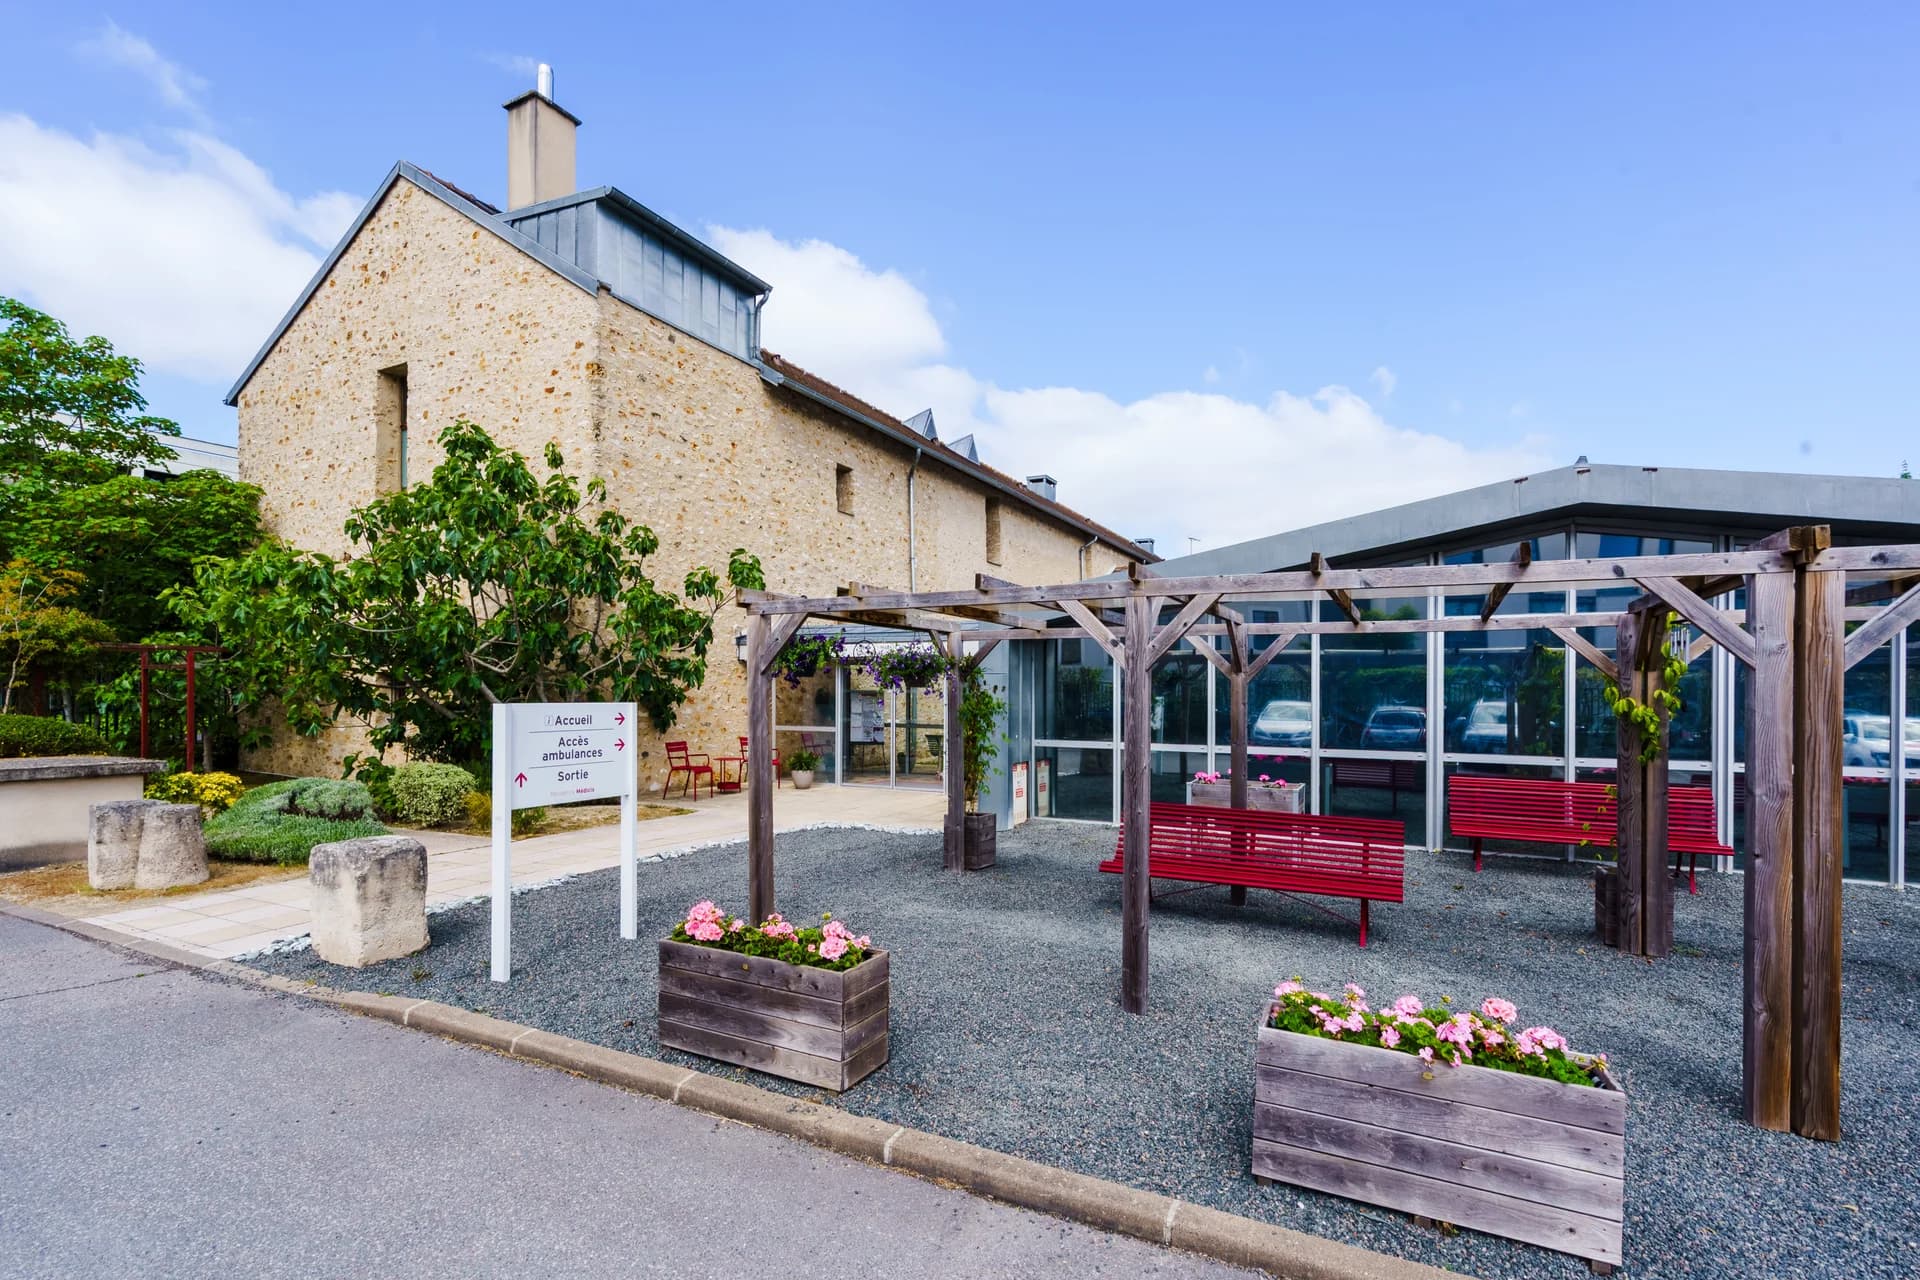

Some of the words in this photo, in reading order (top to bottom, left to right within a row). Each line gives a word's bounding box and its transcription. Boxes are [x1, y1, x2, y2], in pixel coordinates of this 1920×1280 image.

[555, 714, 592, 726] Accueil
[558, 735, 589, 747] Accès
[542, 748, 603, 762] ambulances
[557, 769, 589, 782] Sortie
